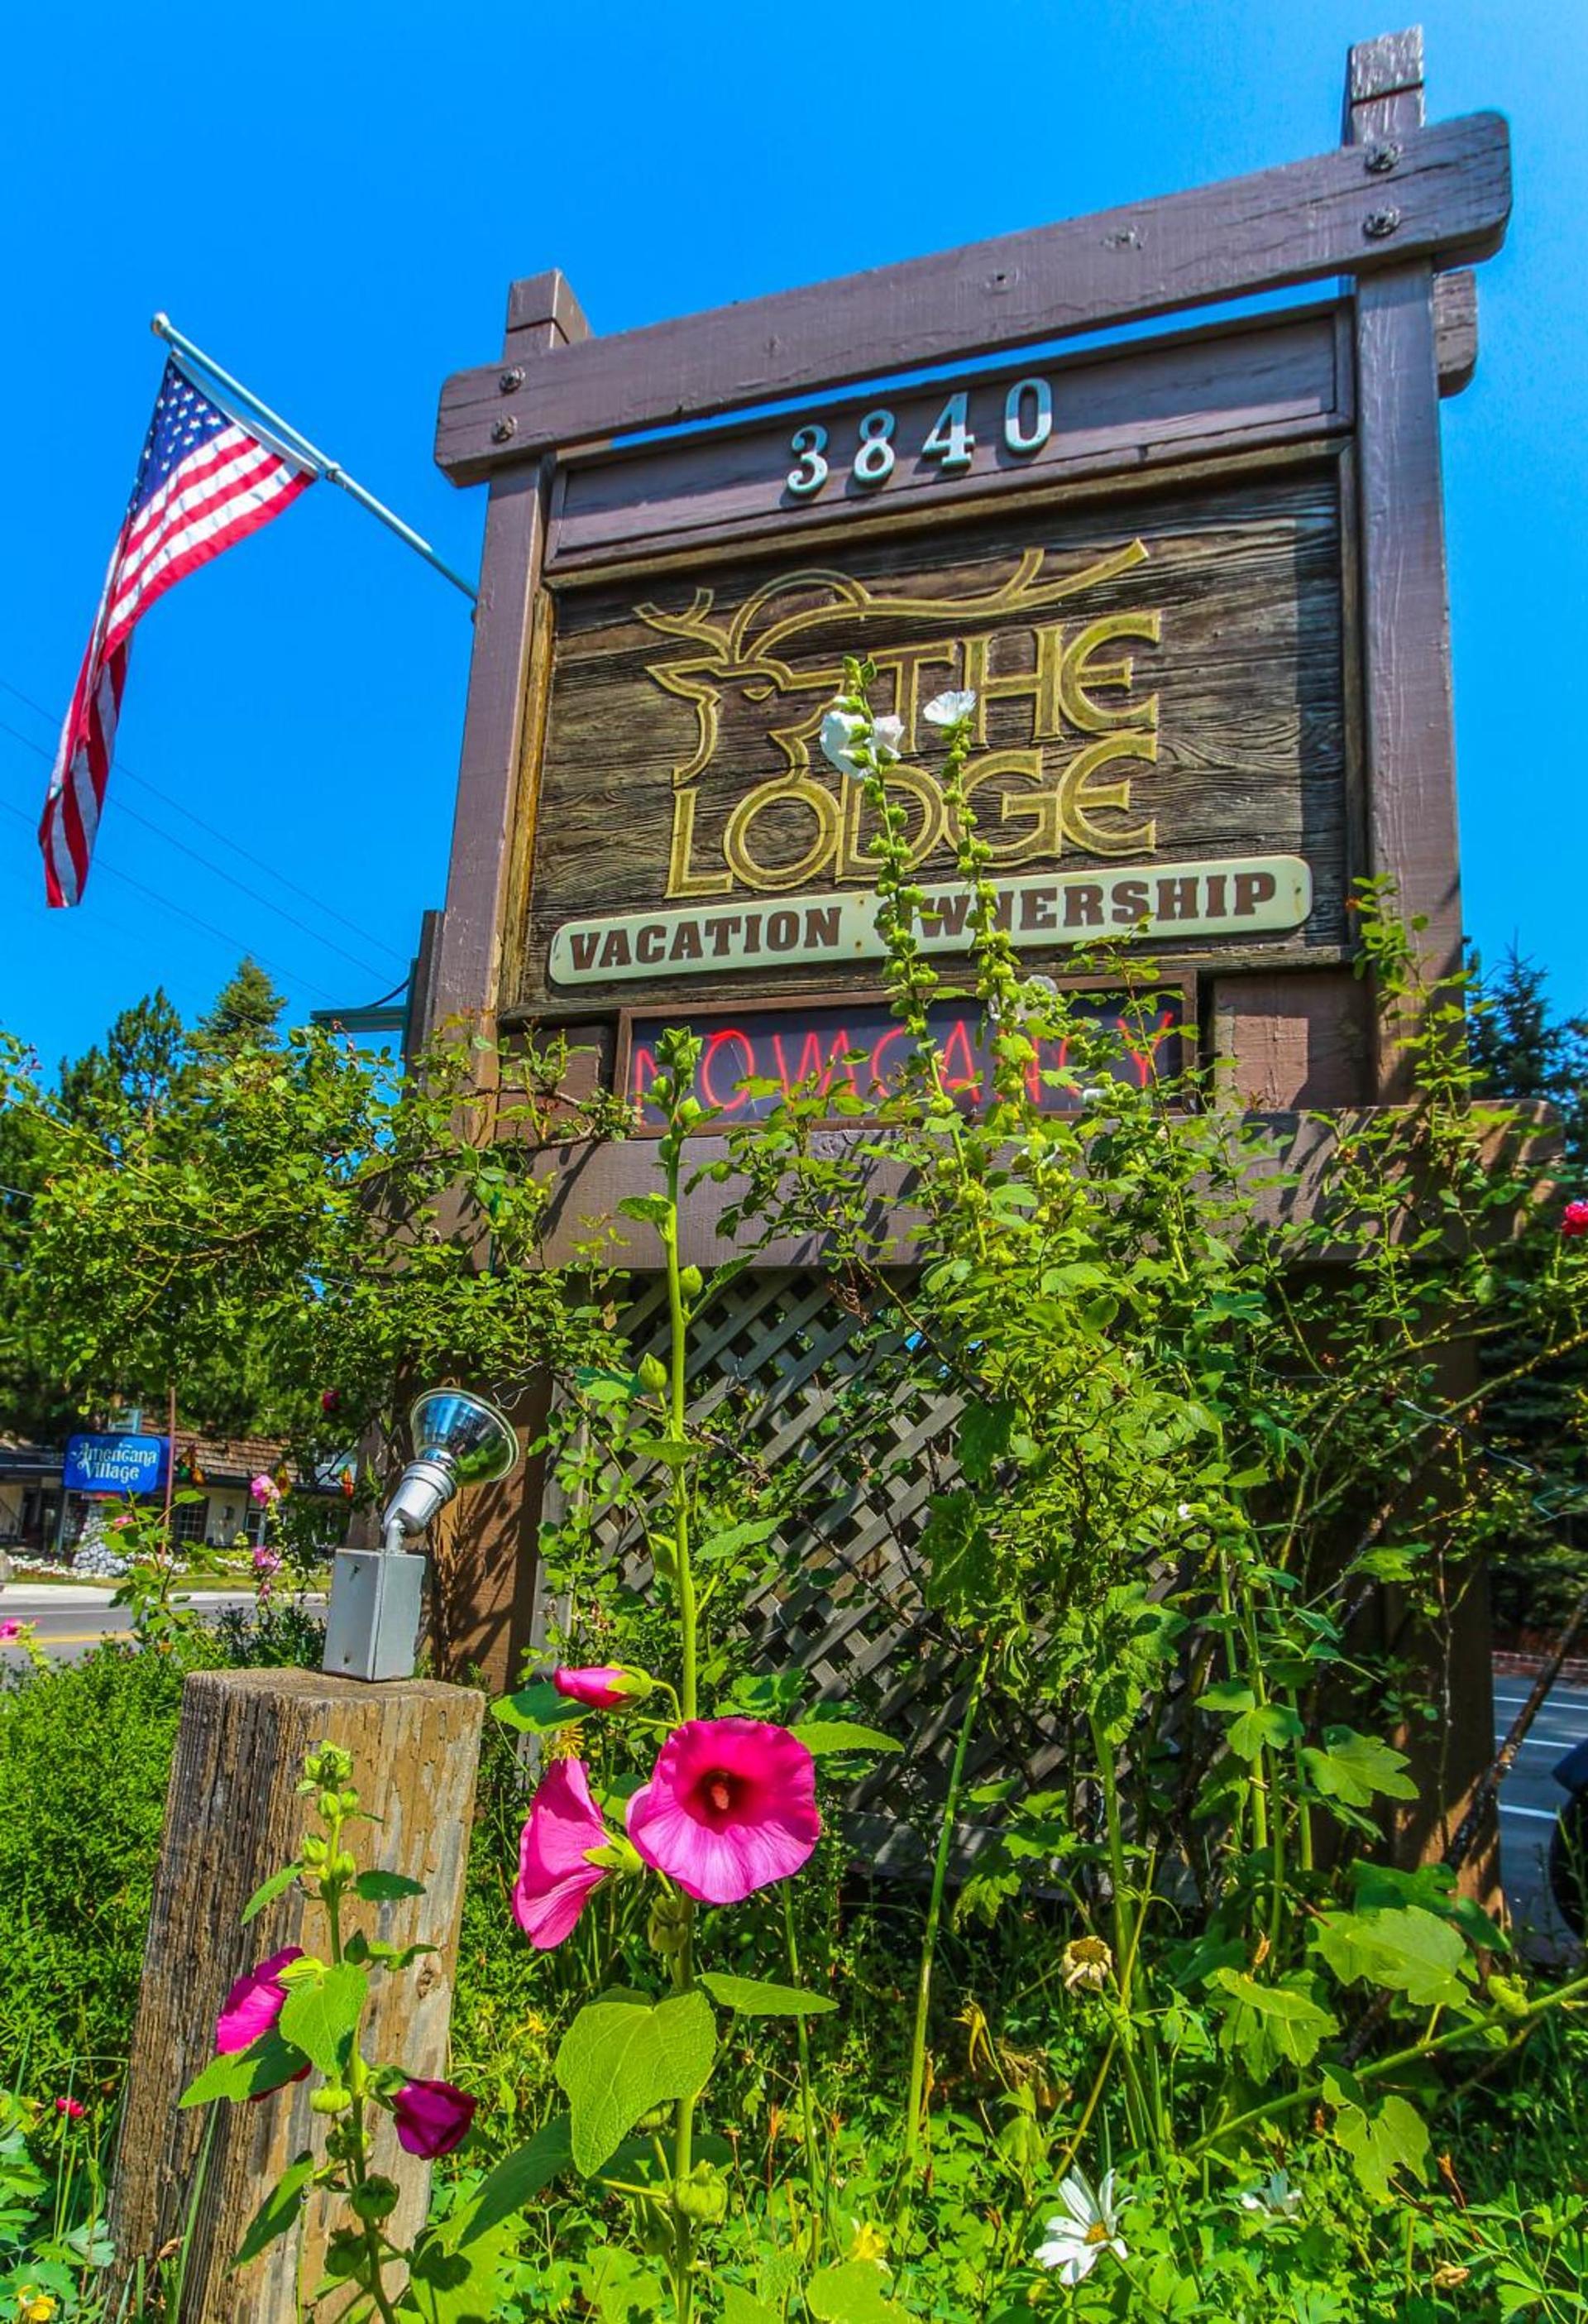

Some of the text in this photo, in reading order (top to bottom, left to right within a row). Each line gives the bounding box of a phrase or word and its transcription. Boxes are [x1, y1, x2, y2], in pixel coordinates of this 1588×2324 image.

[787, 377, 1052, 493] 3840
[868, 610, 1160, 755] THE
[665, 734, 1158, 898] LODGE
[570, 907, 841, 970] VACATION
[69, 1442, 157, 1467] Americana
[77, 1460, 140, 1483] Village
